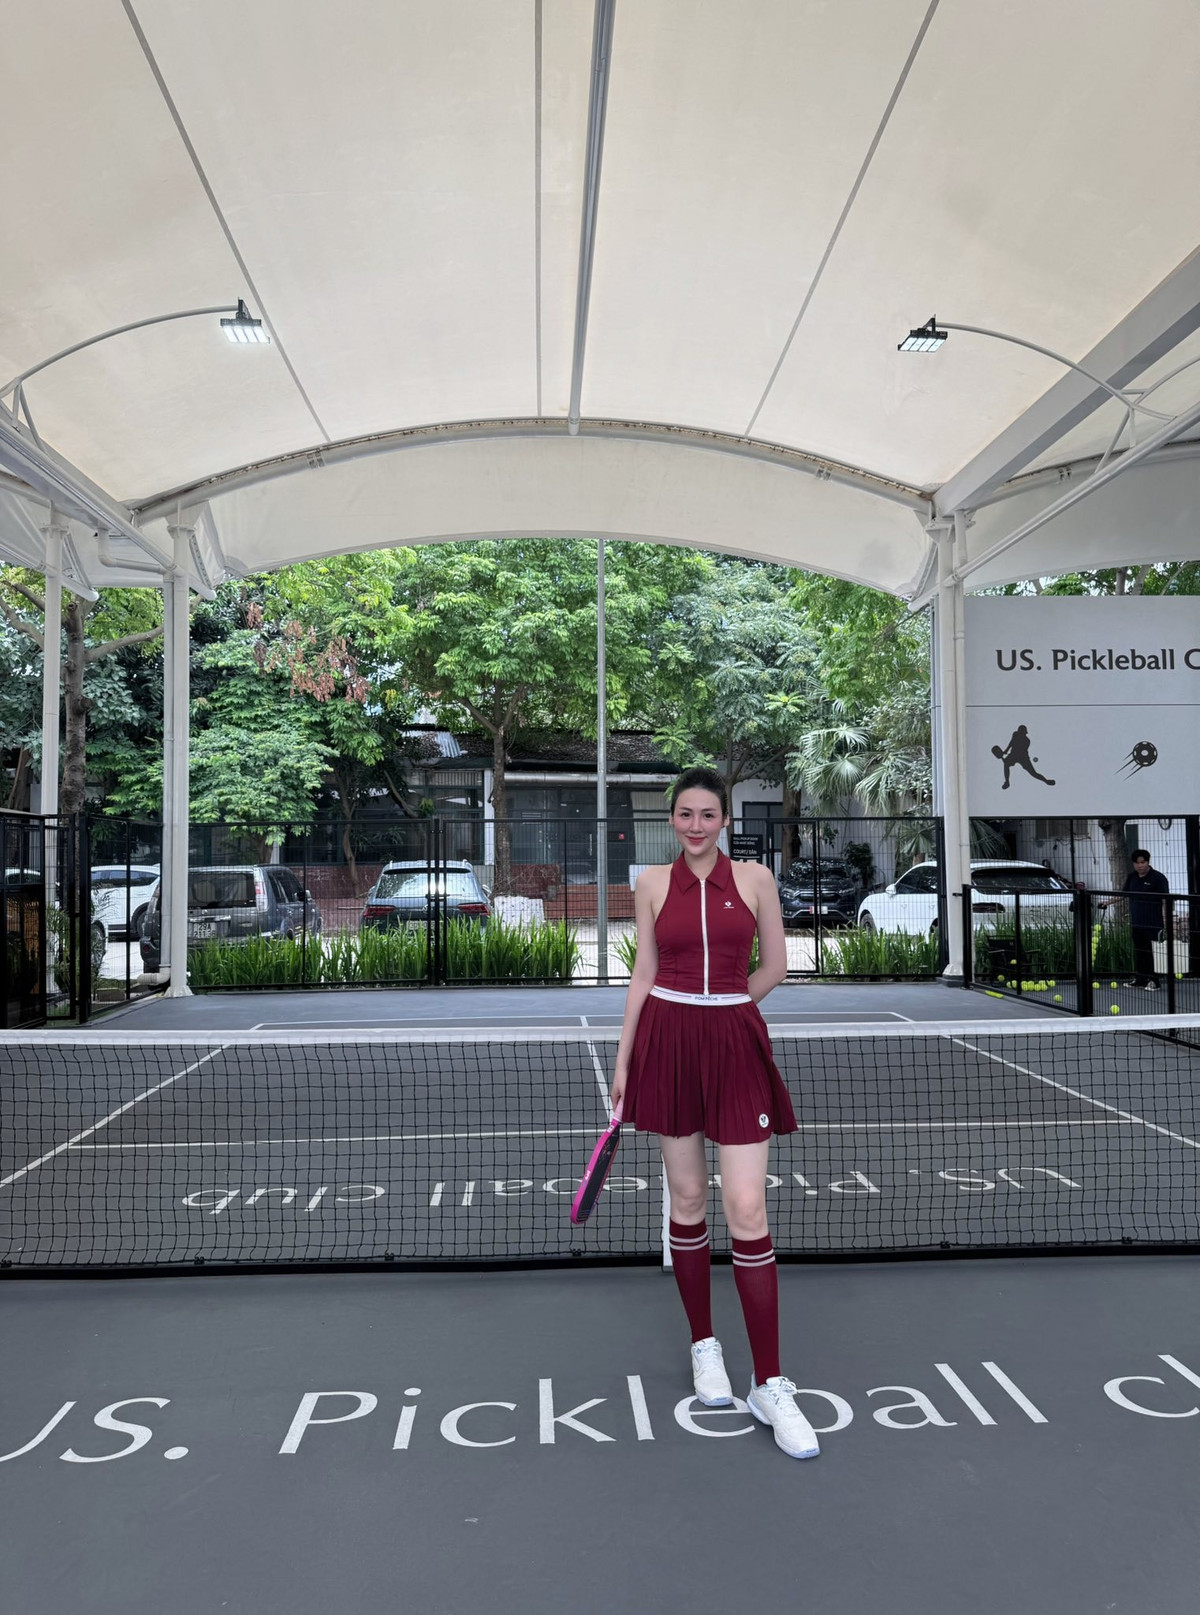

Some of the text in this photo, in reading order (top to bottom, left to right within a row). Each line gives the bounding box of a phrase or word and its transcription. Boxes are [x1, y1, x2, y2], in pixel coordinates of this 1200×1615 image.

[996, 649, 1042, 671] US.
[1051, 649, 1175, 671] Pickleball
[182, 1184, 385, 1214] club
